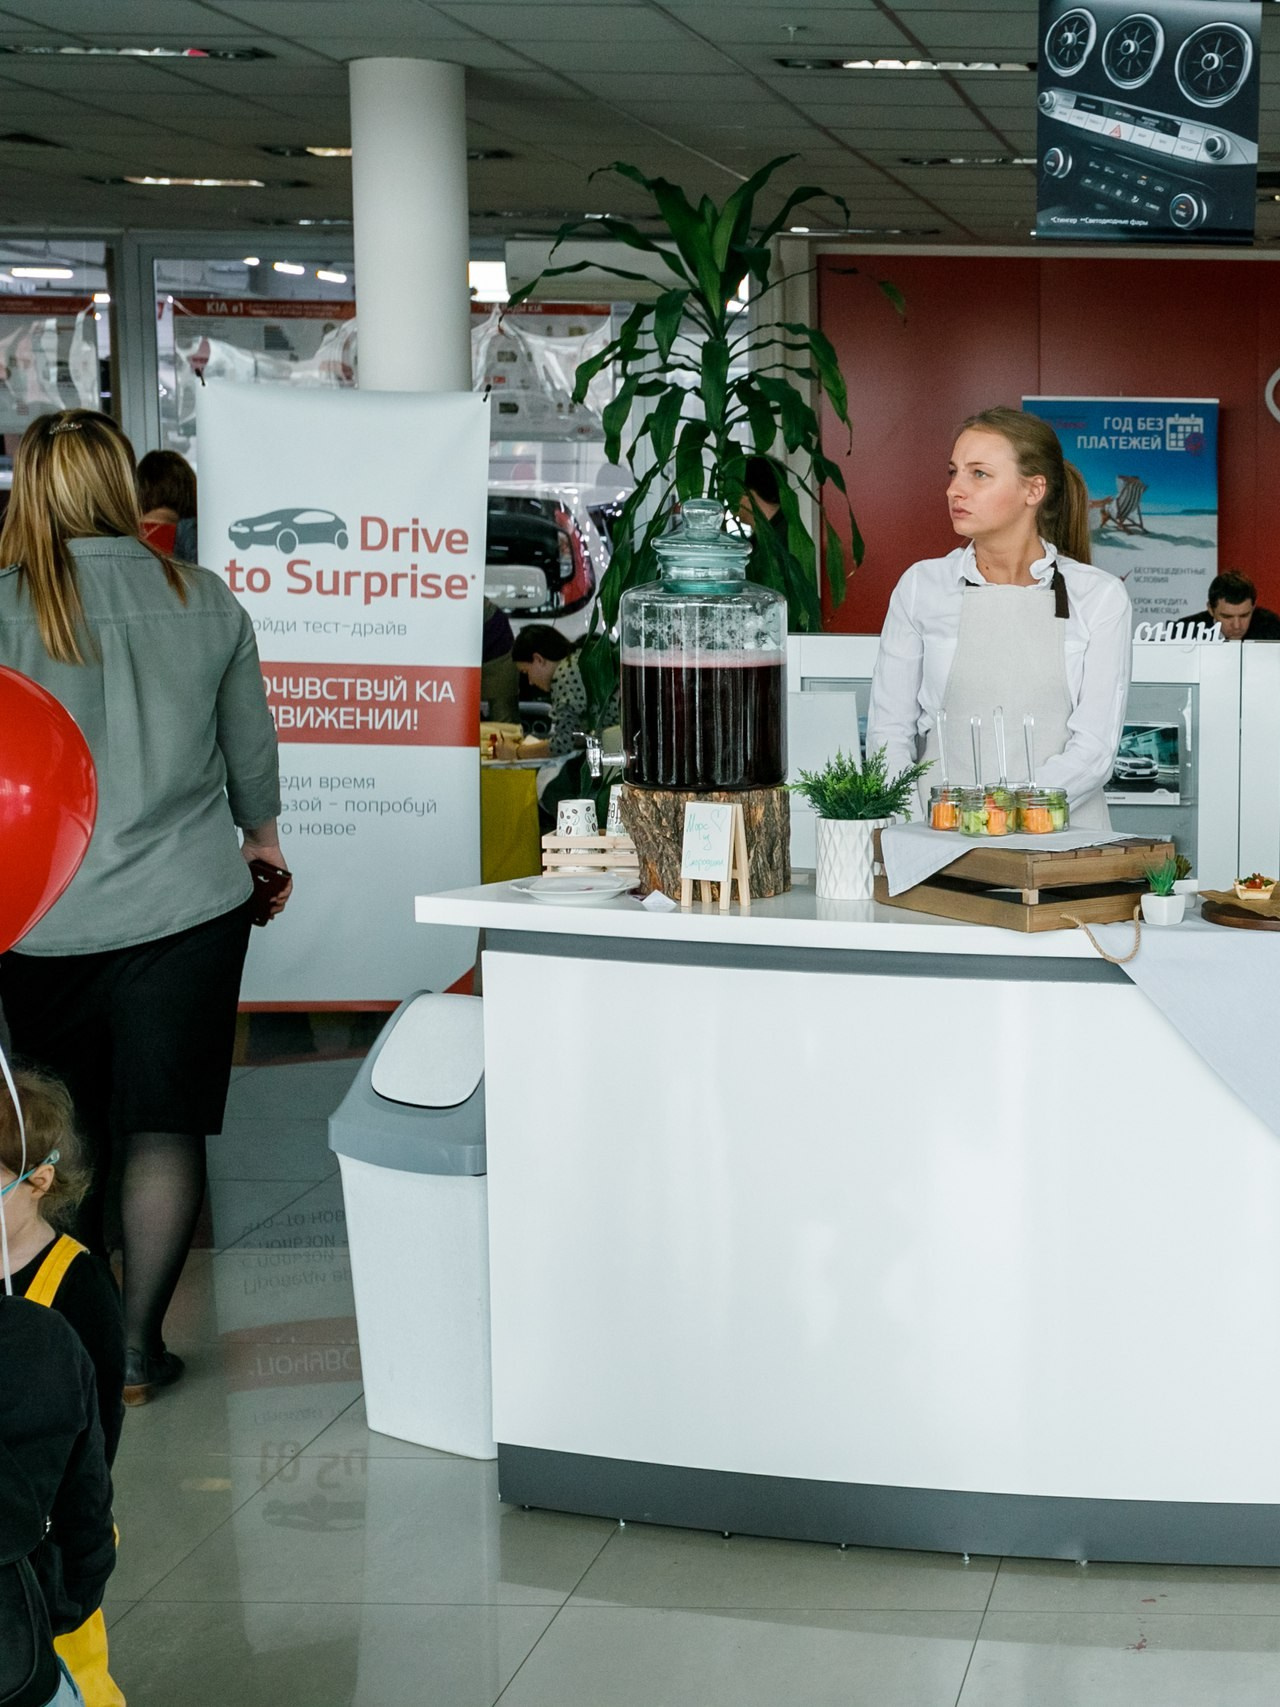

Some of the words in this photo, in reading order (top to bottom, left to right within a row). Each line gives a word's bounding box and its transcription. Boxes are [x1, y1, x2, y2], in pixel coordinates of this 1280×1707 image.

[206, 301, 228, 313] KIA
[1103, 416, 1133, 434] ГОД
[1137, 417, 1164, 431] БЕЗ
[1077, 434, 1162, 450] ПЛАТЕЖЕЙ
[360, 516, 469, 554] Drive
[224, 559, 271, 594] to
[1154, 598, 1189, 606] КРЕДИТА
[303, 618, 407, 637] тест-драйв
[415, 680, 456, 703] KIA
[319, 775, 376, 792] время
[344, 797, 437, 817] попробуй
[299, 822, 357, 836] новое
